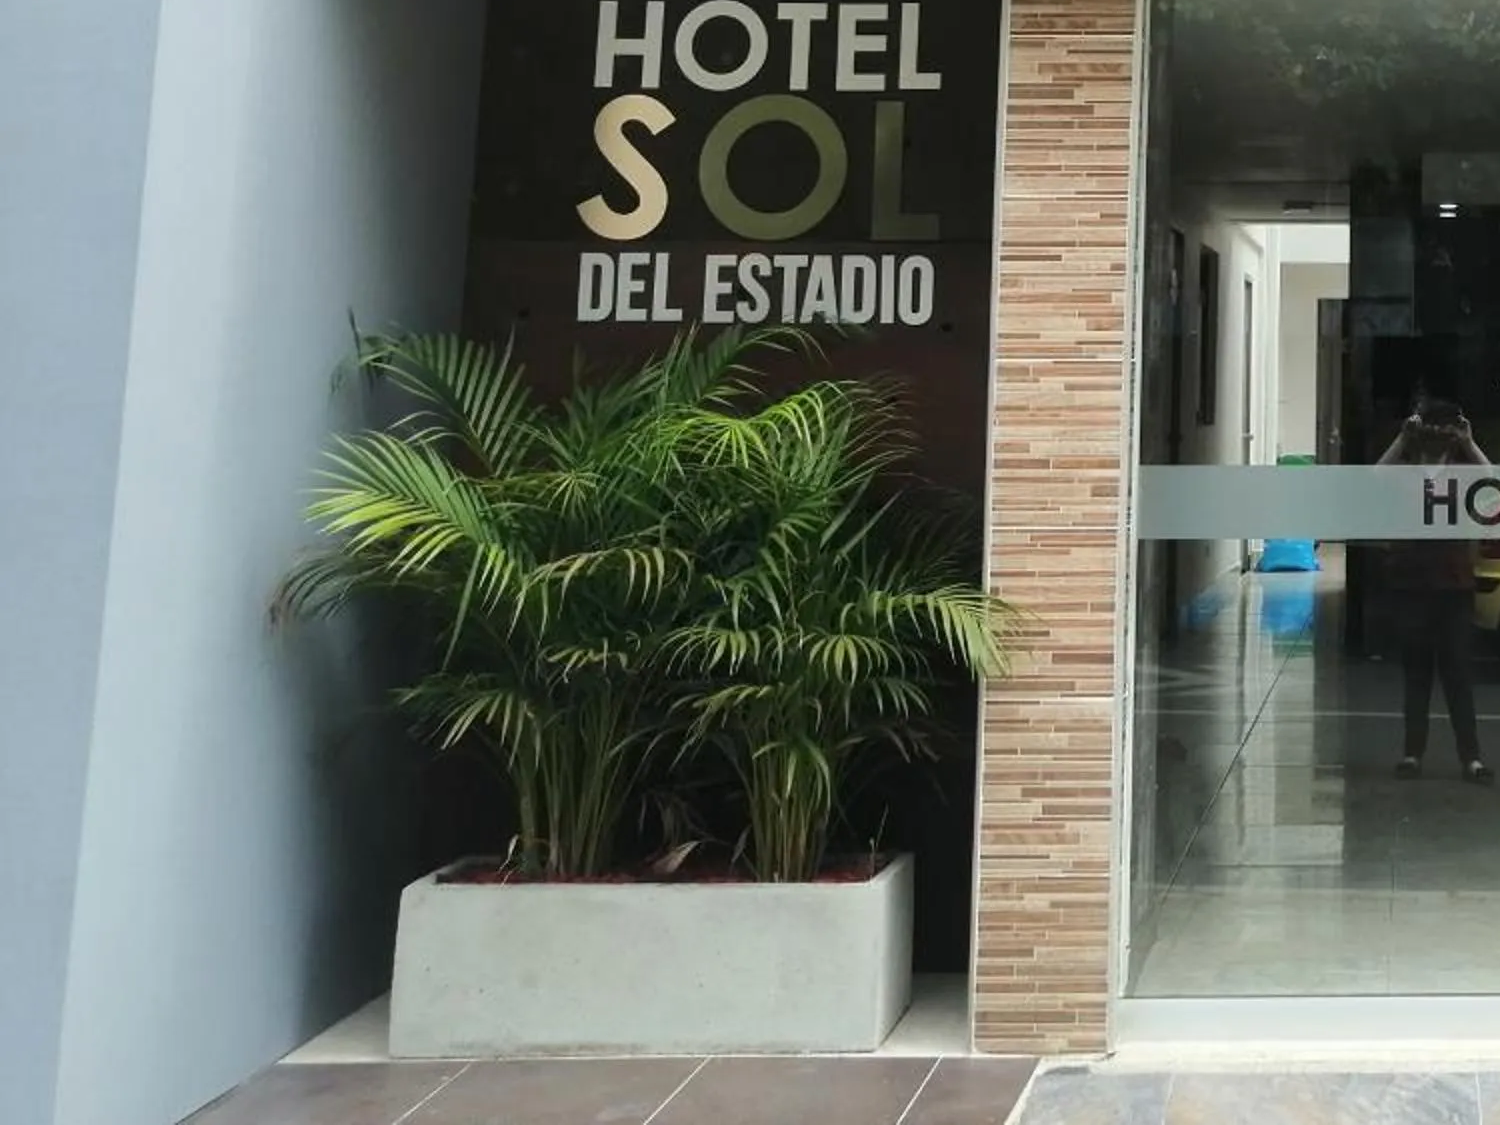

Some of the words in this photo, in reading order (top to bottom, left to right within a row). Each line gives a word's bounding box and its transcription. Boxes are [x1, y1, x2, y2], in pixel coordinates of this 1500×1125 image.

[575, 94, 941, 241] SOL
[577, 252, 683, 323] DEL
[703, 252, 935, 326] ESTADIO
